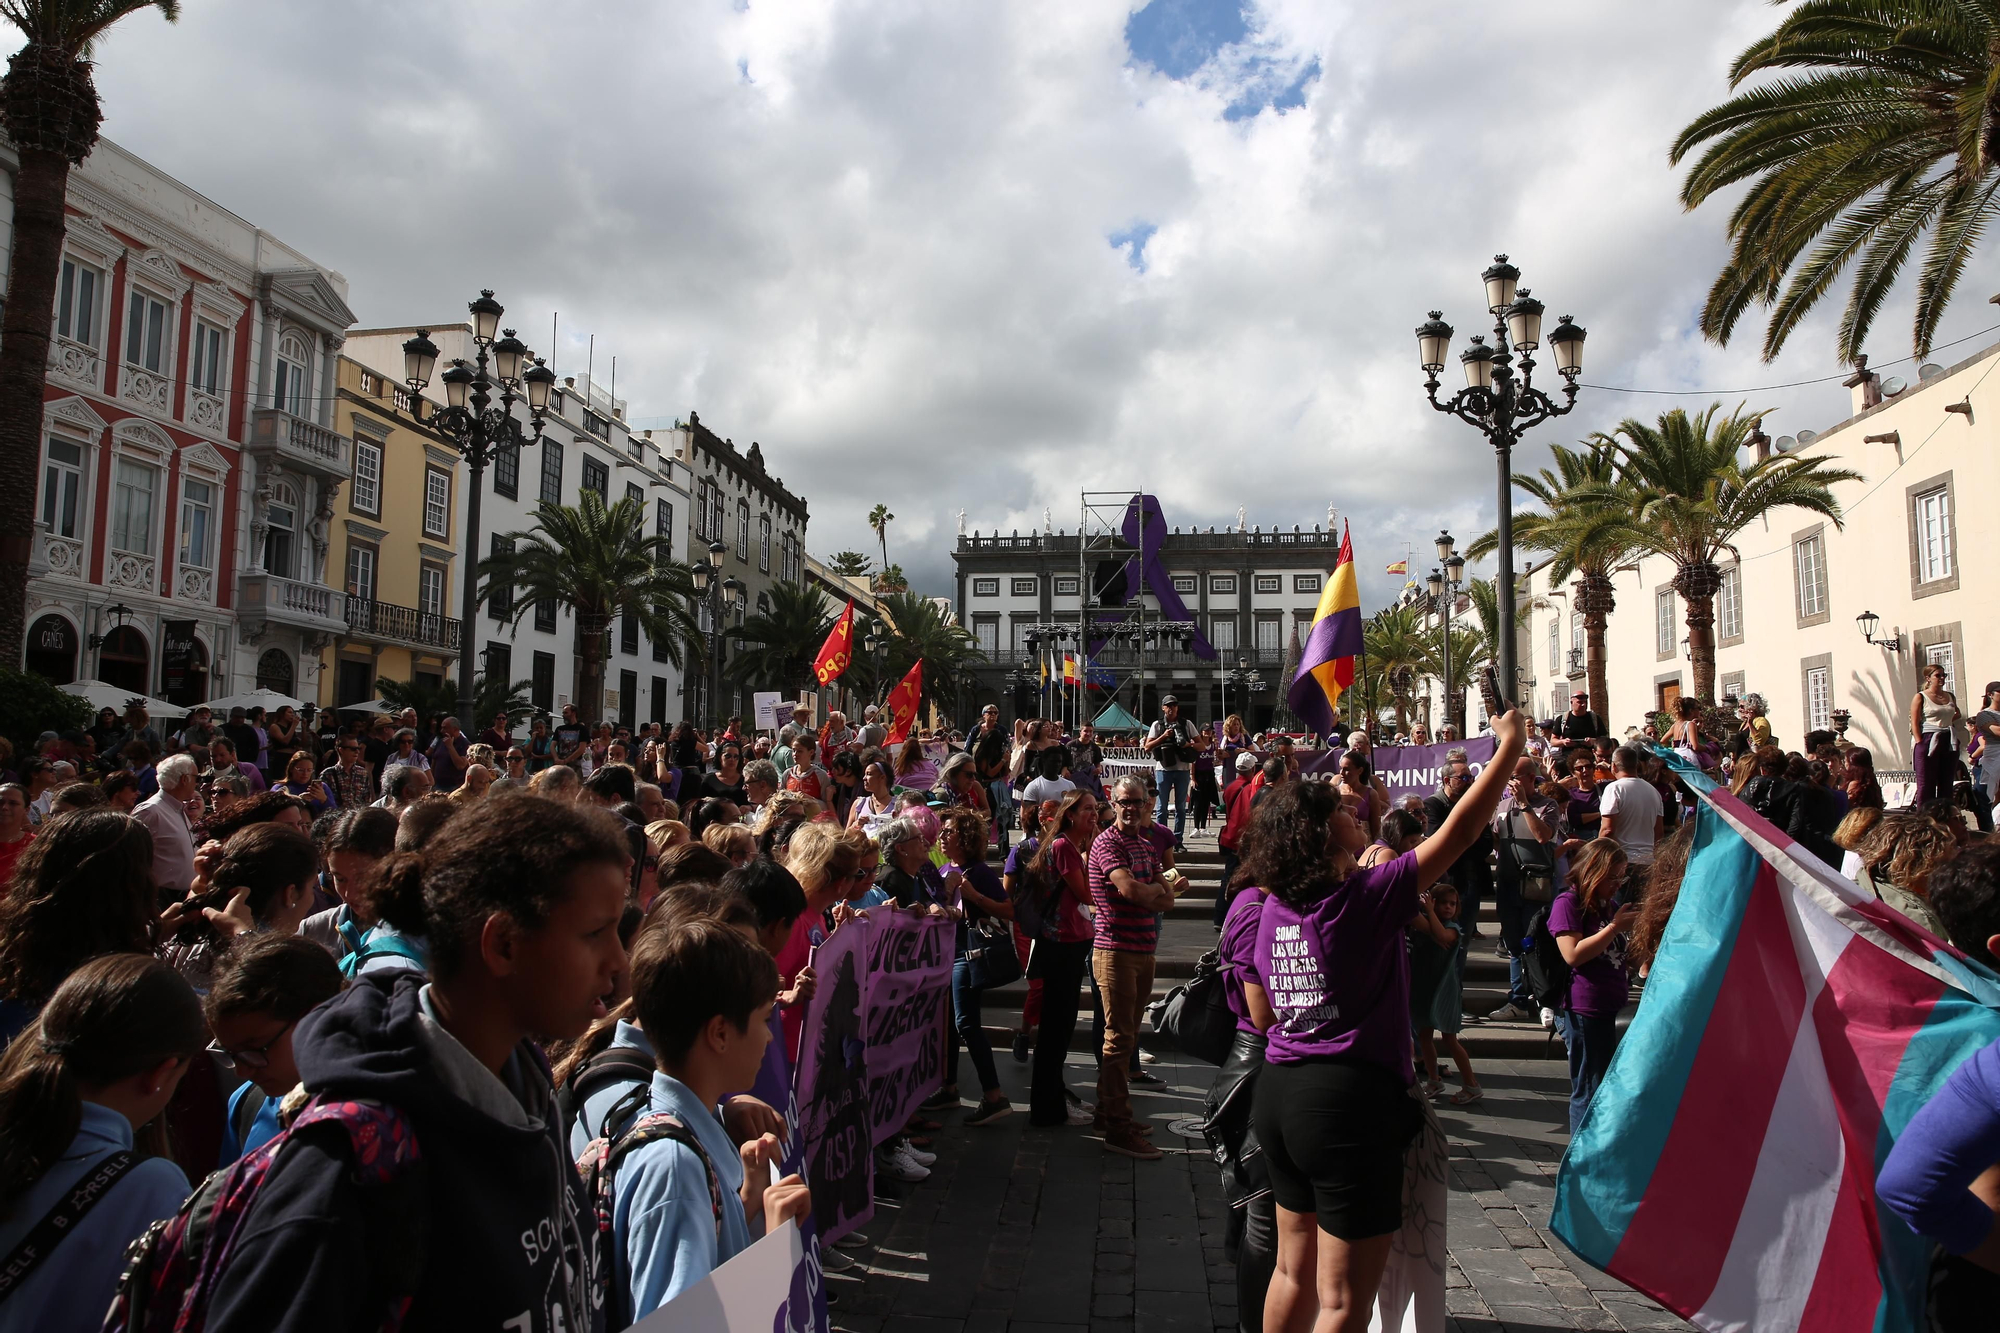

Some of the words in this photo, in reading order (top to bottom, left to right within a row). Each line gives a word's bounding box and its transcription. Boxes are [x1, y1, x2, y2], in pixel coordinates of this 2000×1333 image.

[1102, 747, 1152, 760] SESINATOS
[1275, 925, 1301, 941] SOMOS
[1272, 943, 1285, 957] LAS
[1269, 976, 1278, 990] DE
[1279, 975, 1292, 991] LAS
[1292, 972, 1326, 991] BRUJAS
[1274, 991, 1288, 1007] DEL
